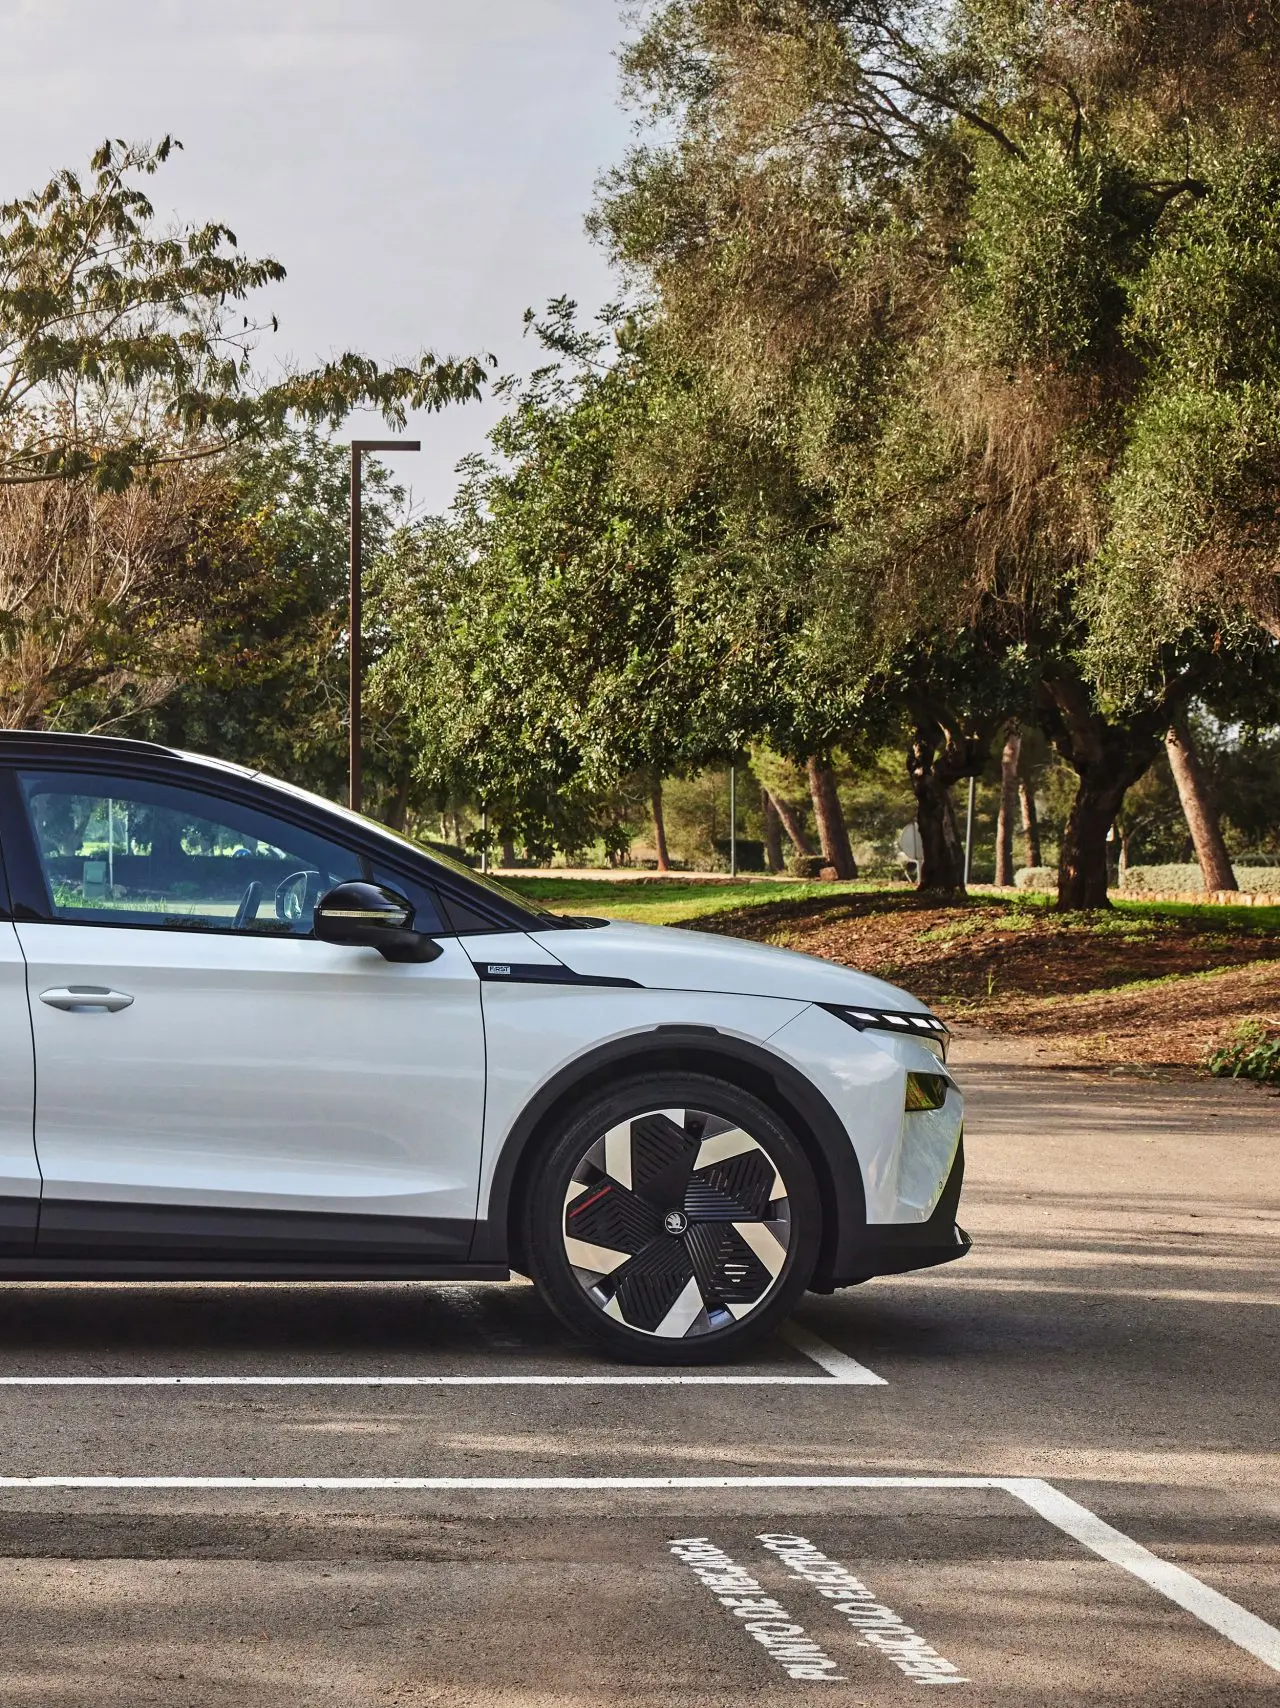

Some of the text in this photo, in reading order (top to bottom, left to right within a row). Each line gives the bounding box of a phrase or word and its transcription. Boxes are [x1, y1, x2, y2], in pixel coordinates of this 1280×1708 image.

[666, 1537, 849, 1680] PUNTO DE RECARGA
[755, 1533, 971, 1684] VEHÍCULO ELÉCTRICO
